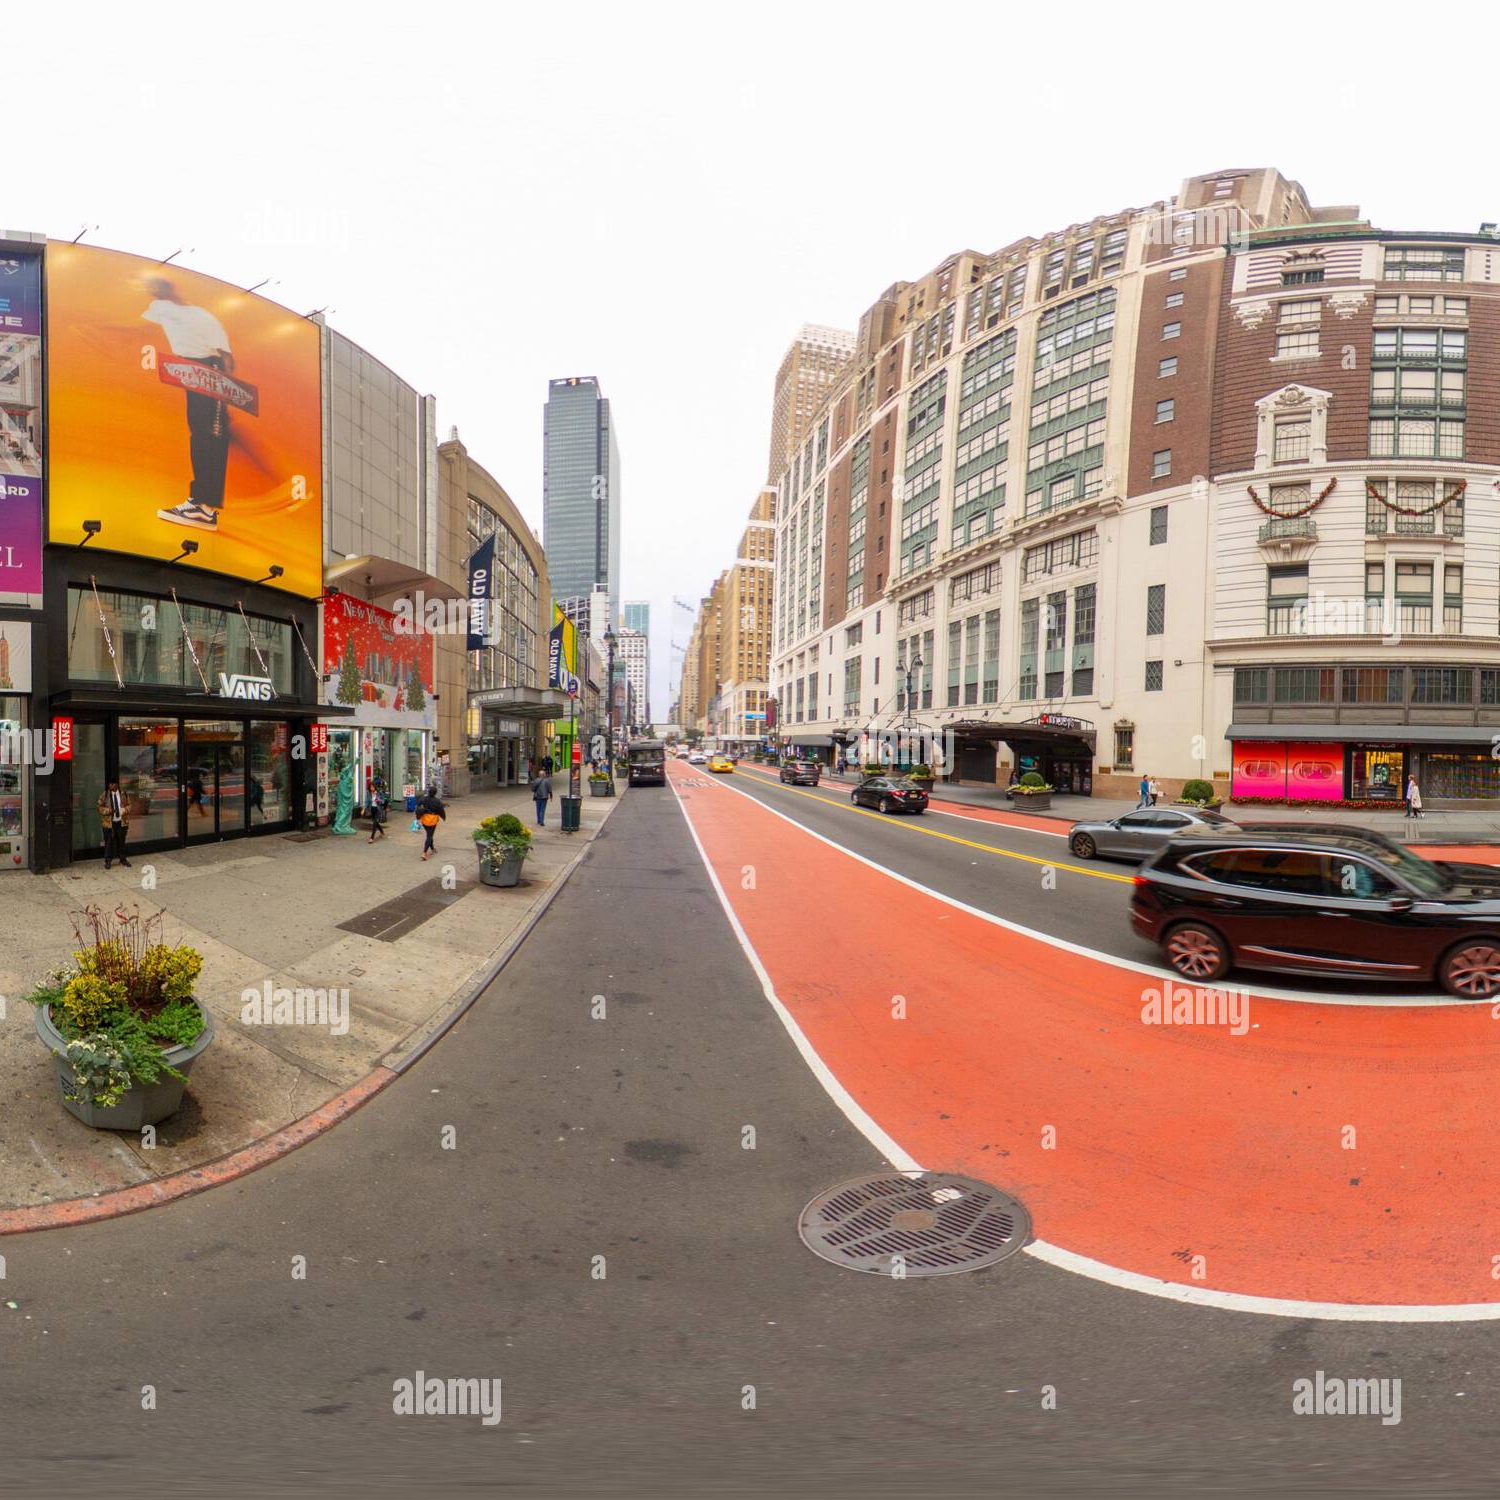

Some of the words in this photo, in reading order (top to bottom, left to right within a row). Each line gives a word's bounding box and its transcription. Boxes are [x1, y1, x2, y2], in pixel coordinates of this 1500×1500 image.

[472, 569, 487, 596] OLD
[471, 598, 485, 636] NAVY
[550, 639, 560, 656] OLD
[549, 658, 559, 680] NAVY
[219, 672, 271, 701] VANS
[58, 722, 70, 754] VANS
[311, 727, 319, 750] VANS
